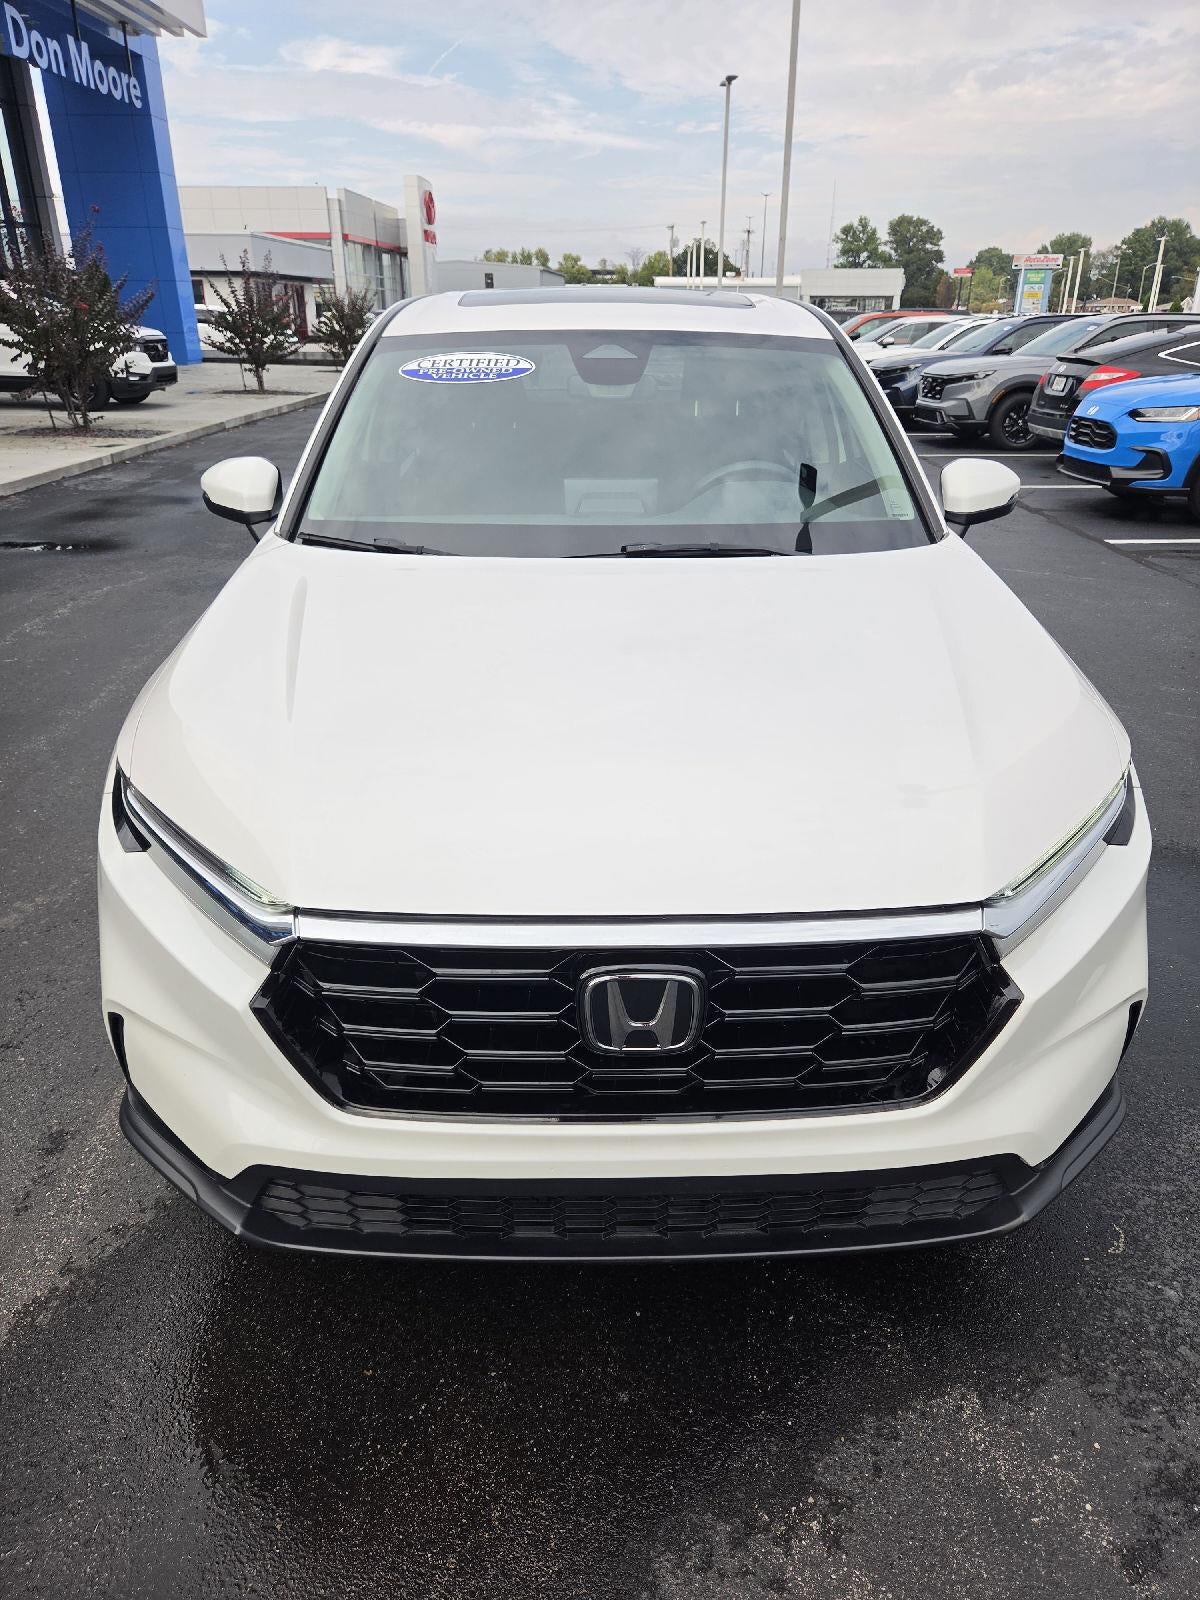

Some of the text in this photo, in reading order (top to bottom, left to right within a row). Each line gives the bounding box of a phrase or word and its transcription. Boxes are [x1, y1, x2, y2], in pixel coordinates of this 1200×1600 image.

[4, 2, 142, 109] Don Moore
[417, 359, 521, 369] CERTIFIED
[418, 367, 513, 375] PRE-OWNED
